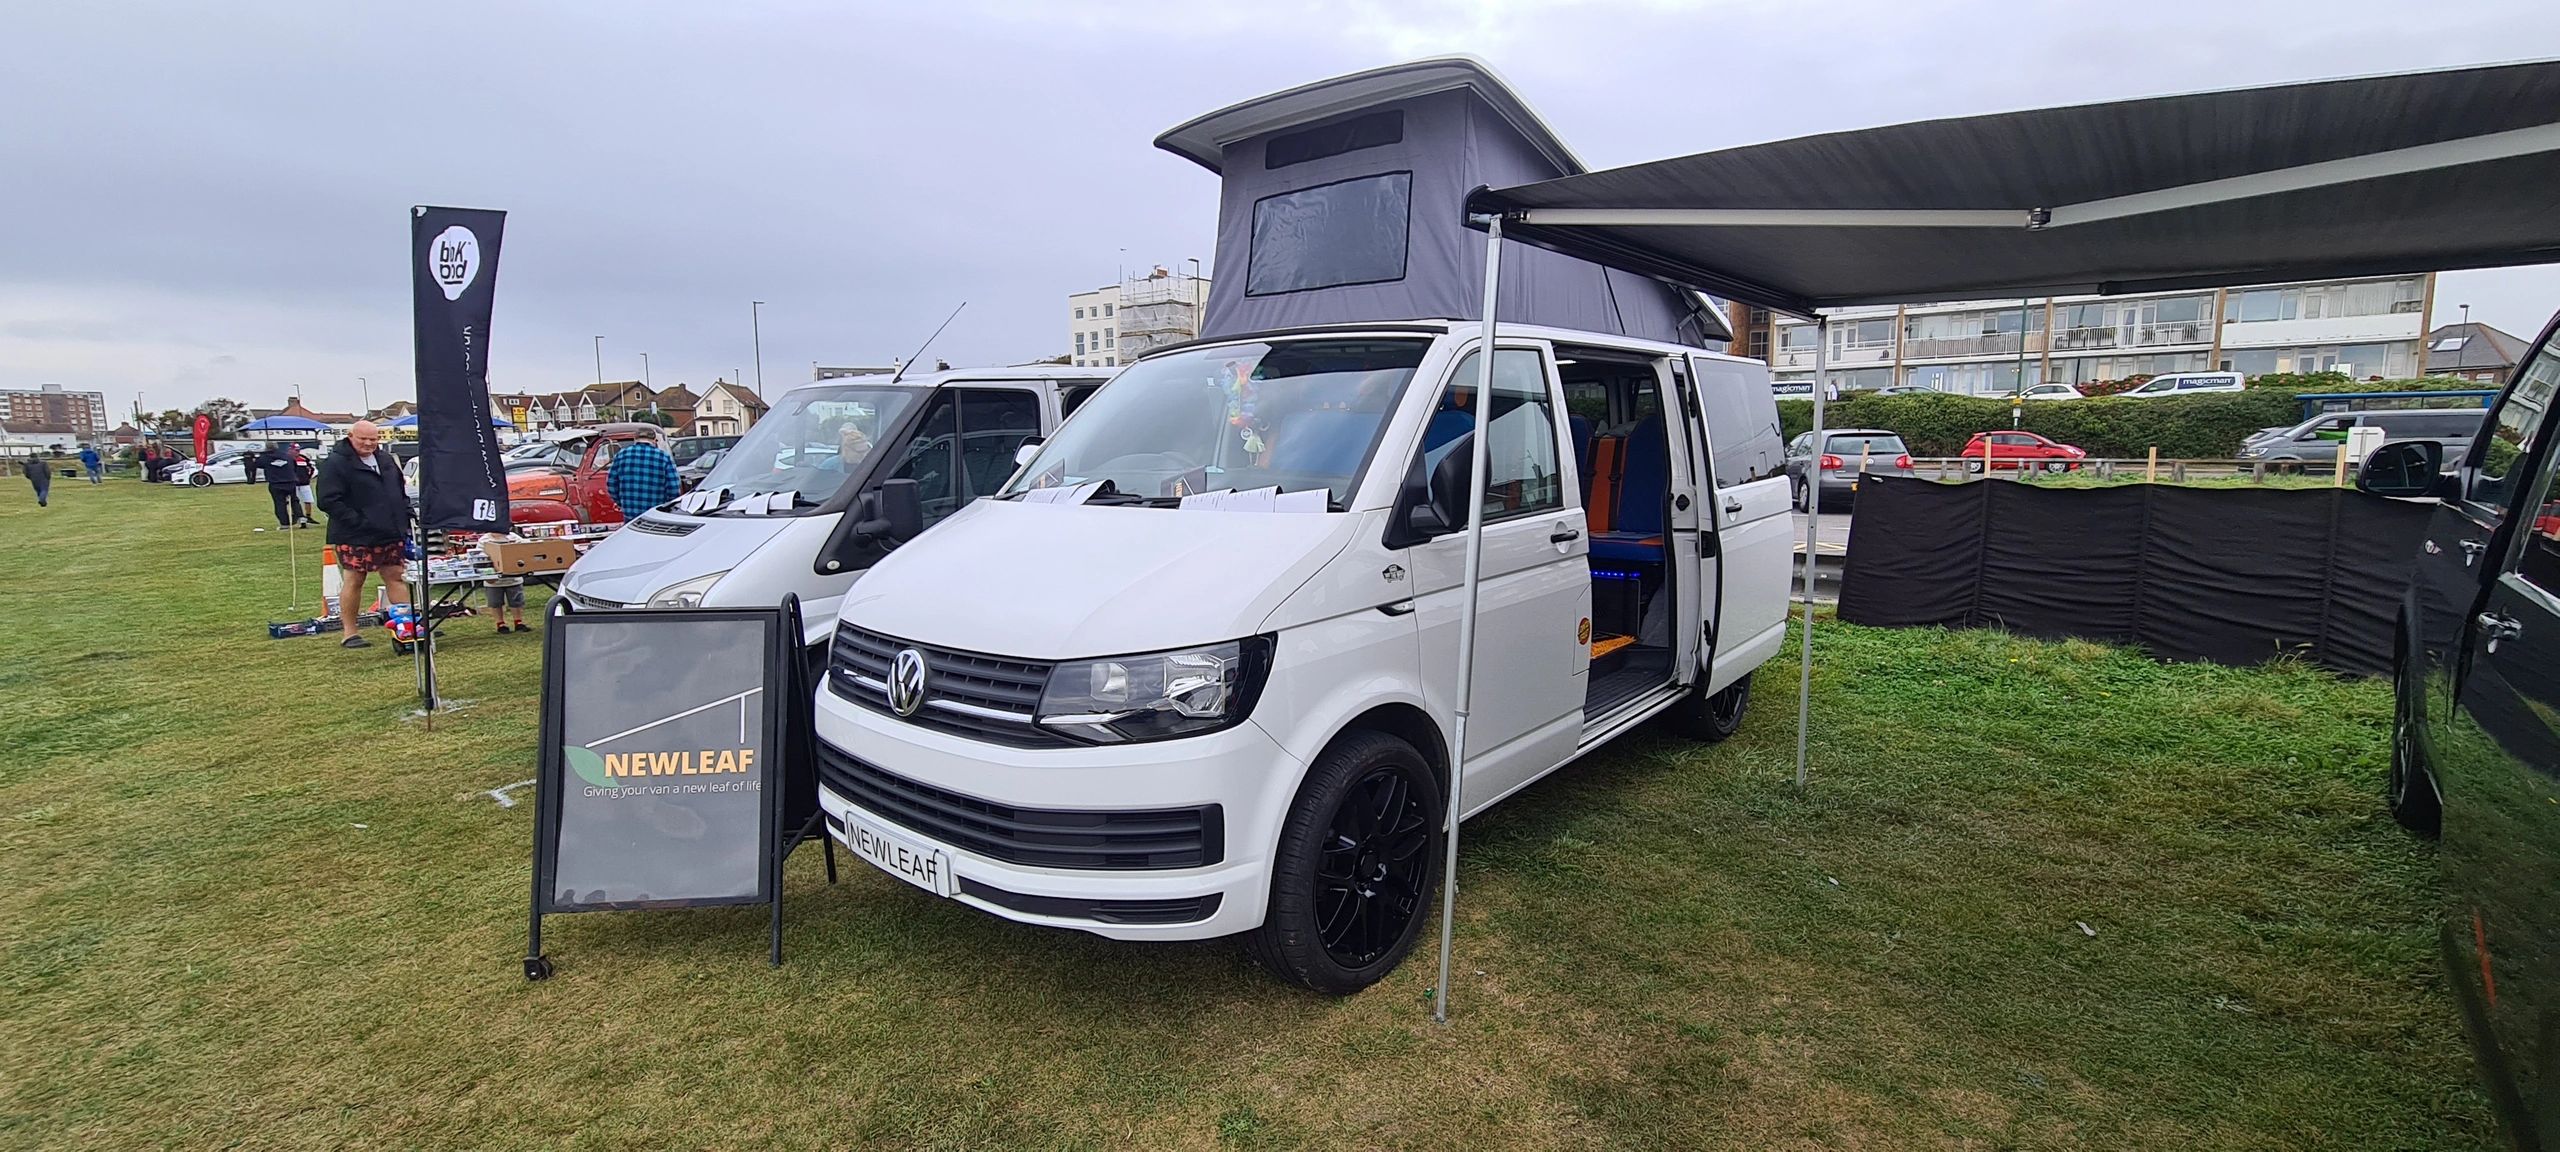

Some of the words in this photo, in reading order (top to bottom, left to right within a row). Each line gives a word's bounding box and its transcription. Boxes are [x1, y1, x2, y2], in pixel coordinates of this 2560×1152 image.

[2183, 378, 2231, 386] magicman
[605, 750, 754, 777] NEWLEAF
[583, 785, 619, 799] Giving
[621, 786, 647, 799] your
[650, 785, 670, 795] van
[673, 785, 679, 794] a
[683, 784, 707, 794] new
[709, 781, 731, 793] leaf
[732, 780, 744, 792] of
[746, 780, 762, 791] life
[850, 822, 938, 883] NEWLEAF
